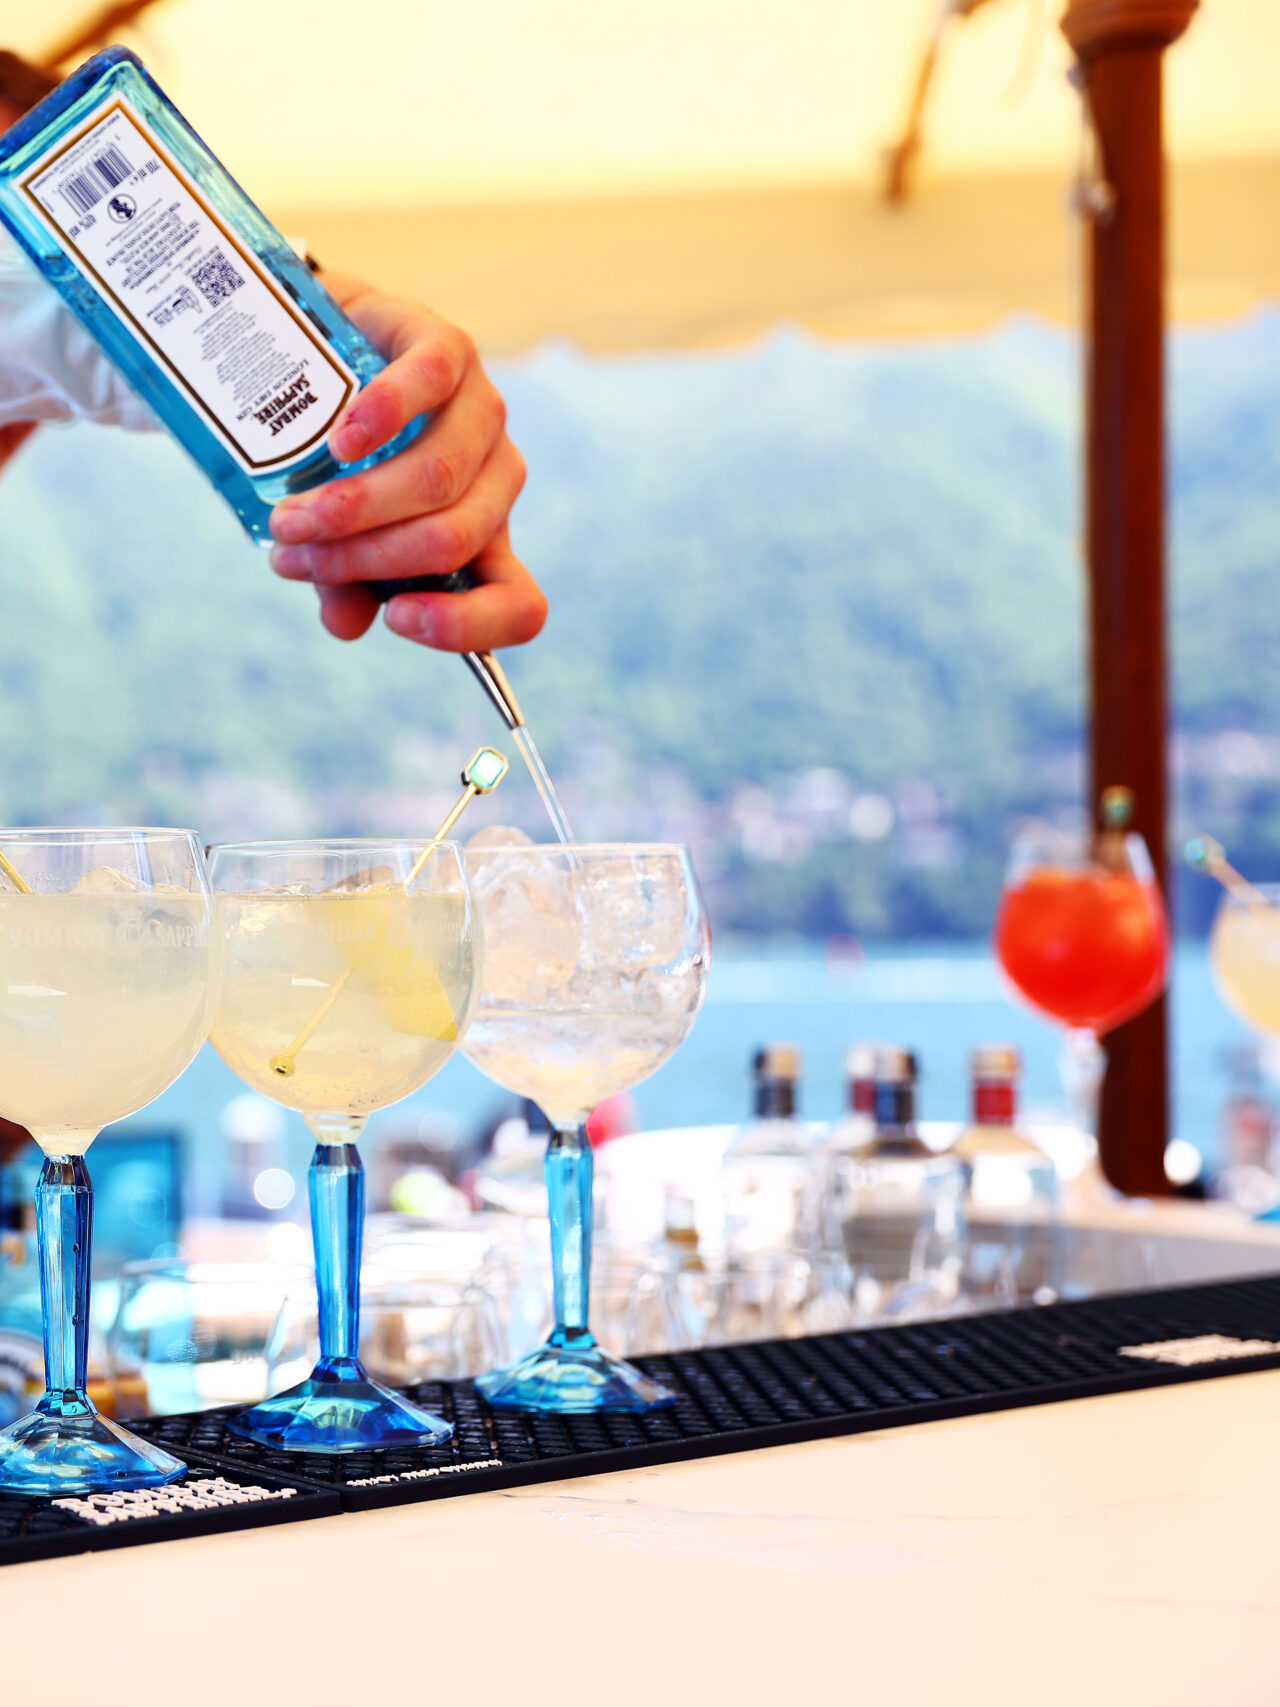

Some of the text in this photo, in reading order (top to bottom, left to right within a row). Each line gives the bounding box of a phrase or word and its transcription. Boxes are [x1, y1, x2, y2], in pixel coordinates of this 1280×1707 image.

[235, 358, 309, 423] LONDON DRY GIN
[253, 372, 311, 426] SAPPHIRE
[265, 389, 318, 437] BOMBAY
